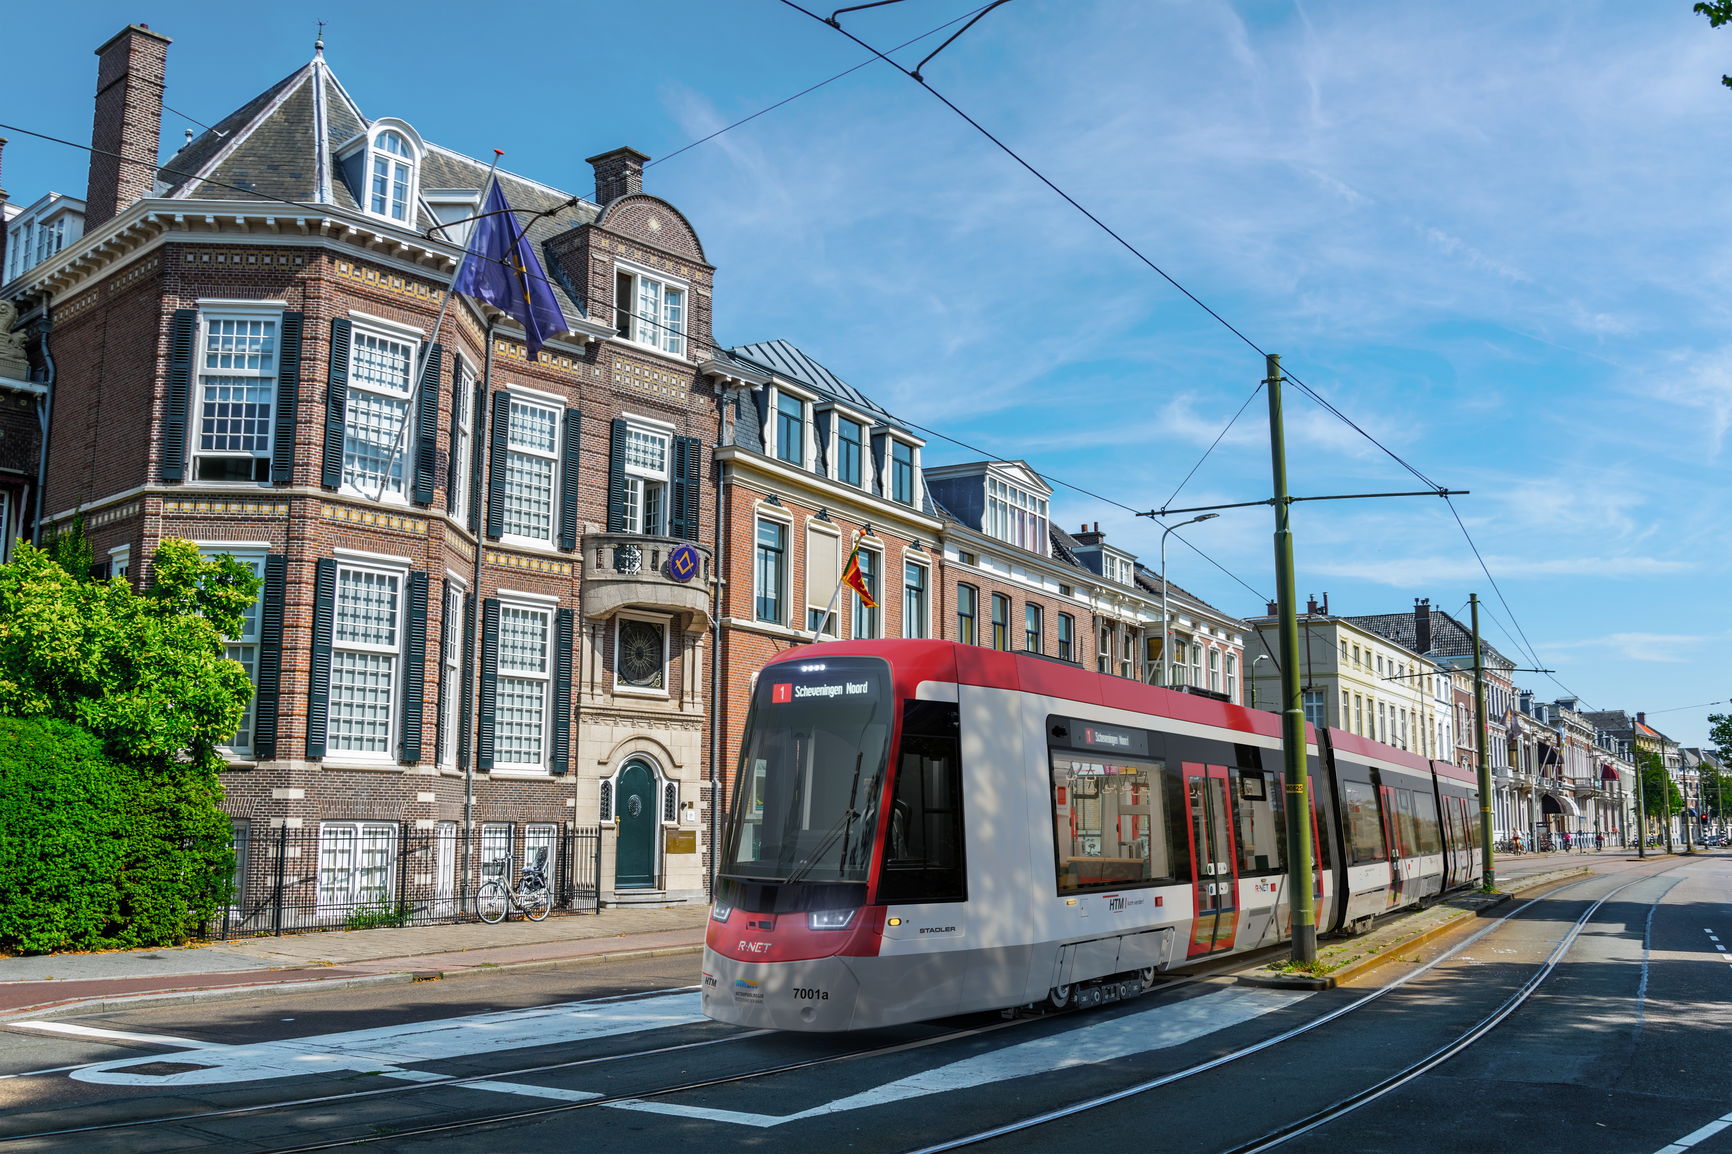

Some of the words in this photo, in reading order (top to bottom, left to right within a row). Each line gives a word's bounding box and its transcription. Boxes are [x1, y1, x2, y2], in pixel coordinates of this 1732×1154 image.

[780, 686, 785, 700] 1
[794, 685, 843, 698] Scheveningen
[846, 681, 868, 695] Noord
[1109, 898, 1124, 911] HTM
[919, 926, 956, 934] STADLER
[704, 977, 717, 987] HTM
[793, 988, 829, 1000] 7001a
